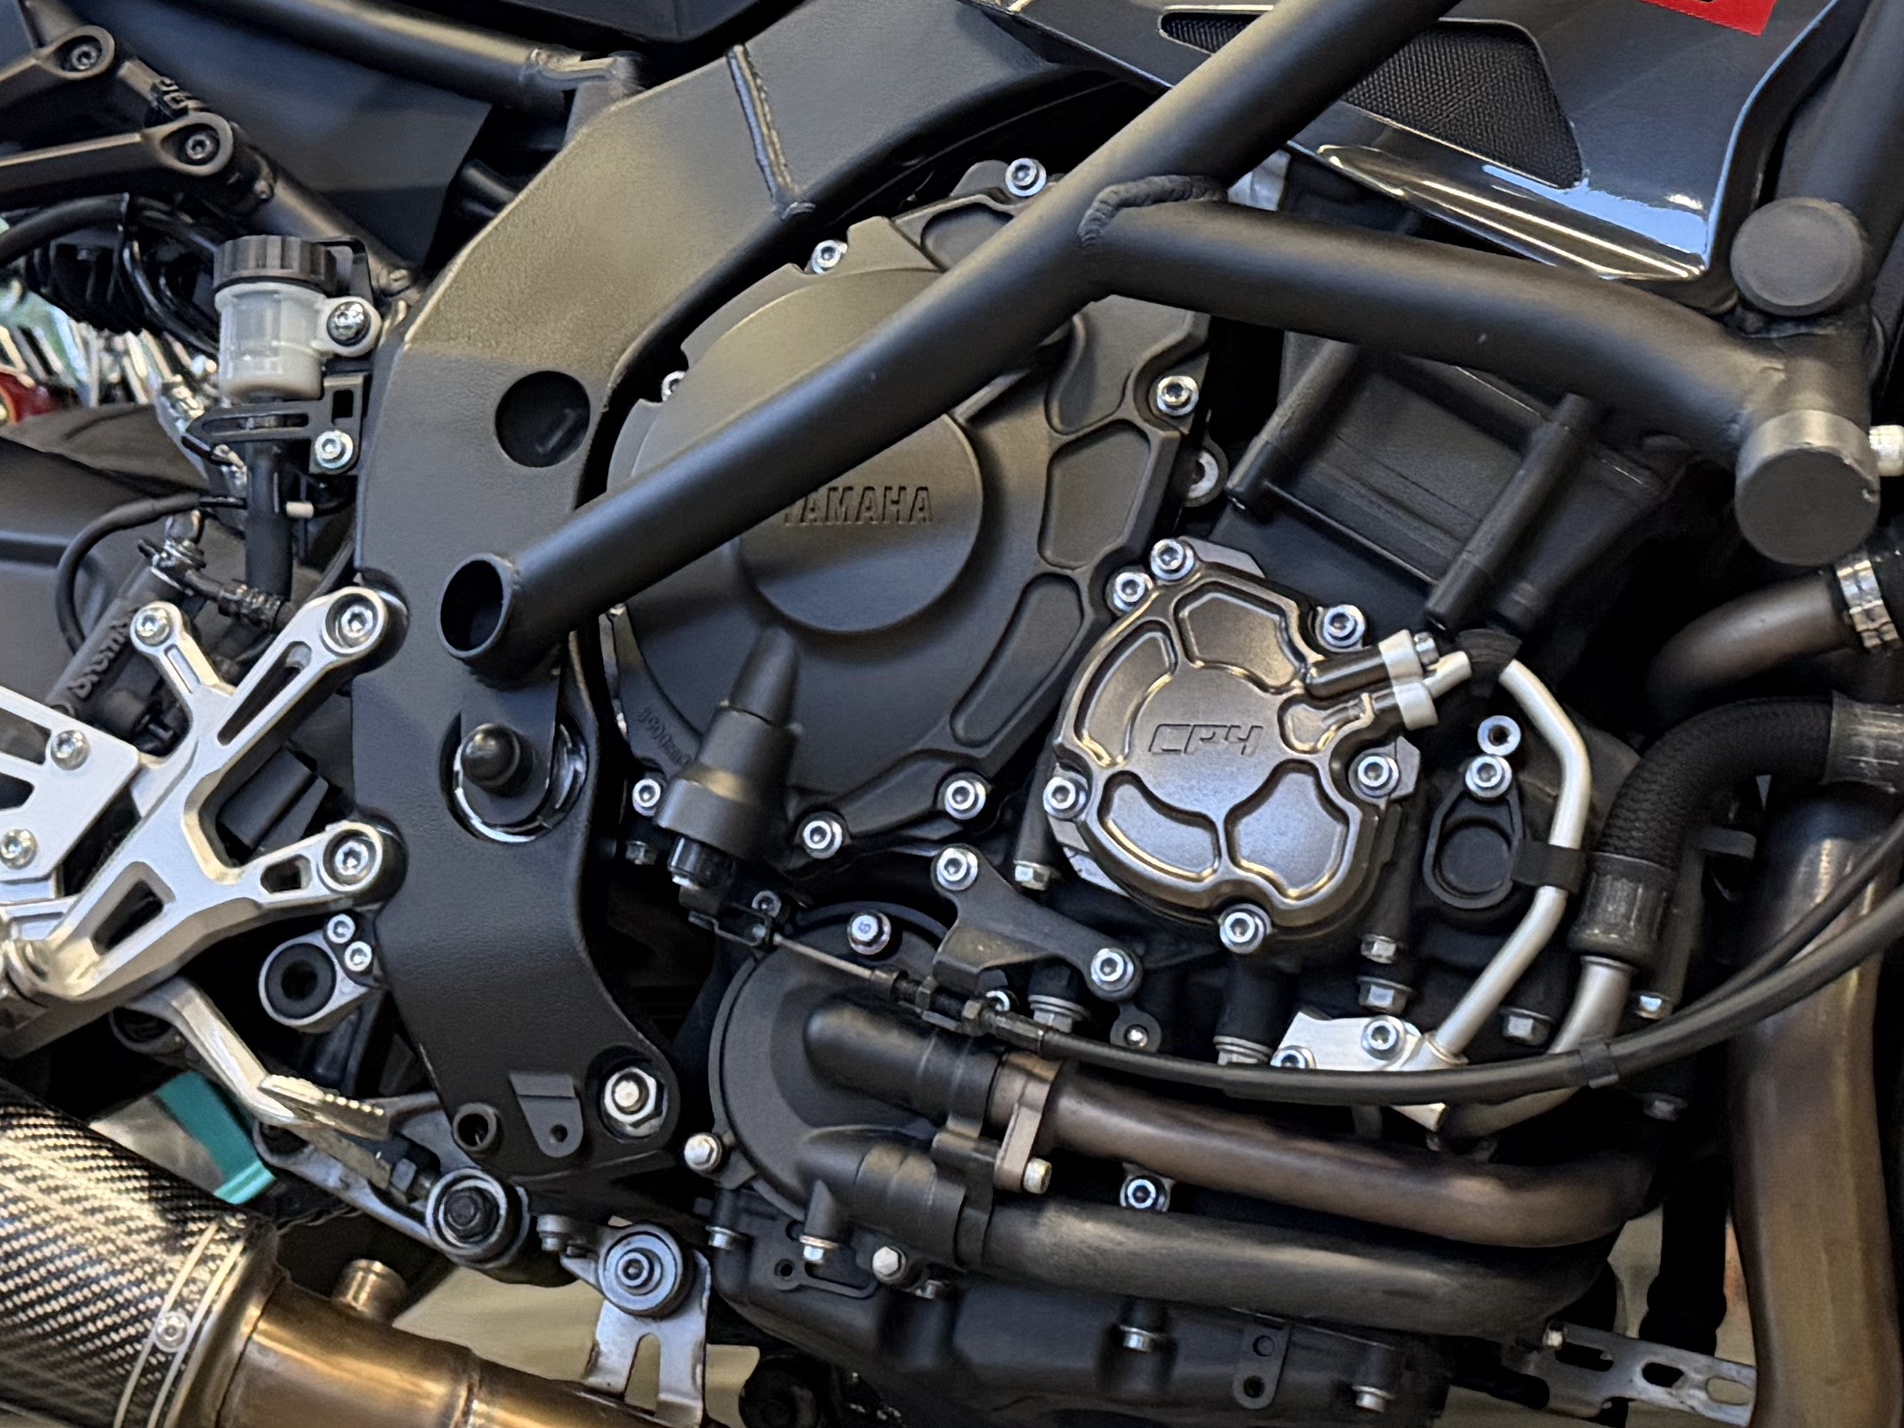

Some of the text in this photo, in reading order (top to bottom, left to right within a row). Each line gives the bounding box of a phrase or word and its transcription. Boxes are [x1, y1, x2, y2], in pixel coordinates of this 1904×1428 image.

[783, 485, 933, 526] AMAHA
[66, 606, 142, 700] bremb
[1148, 723, 1264, 756] CP4
